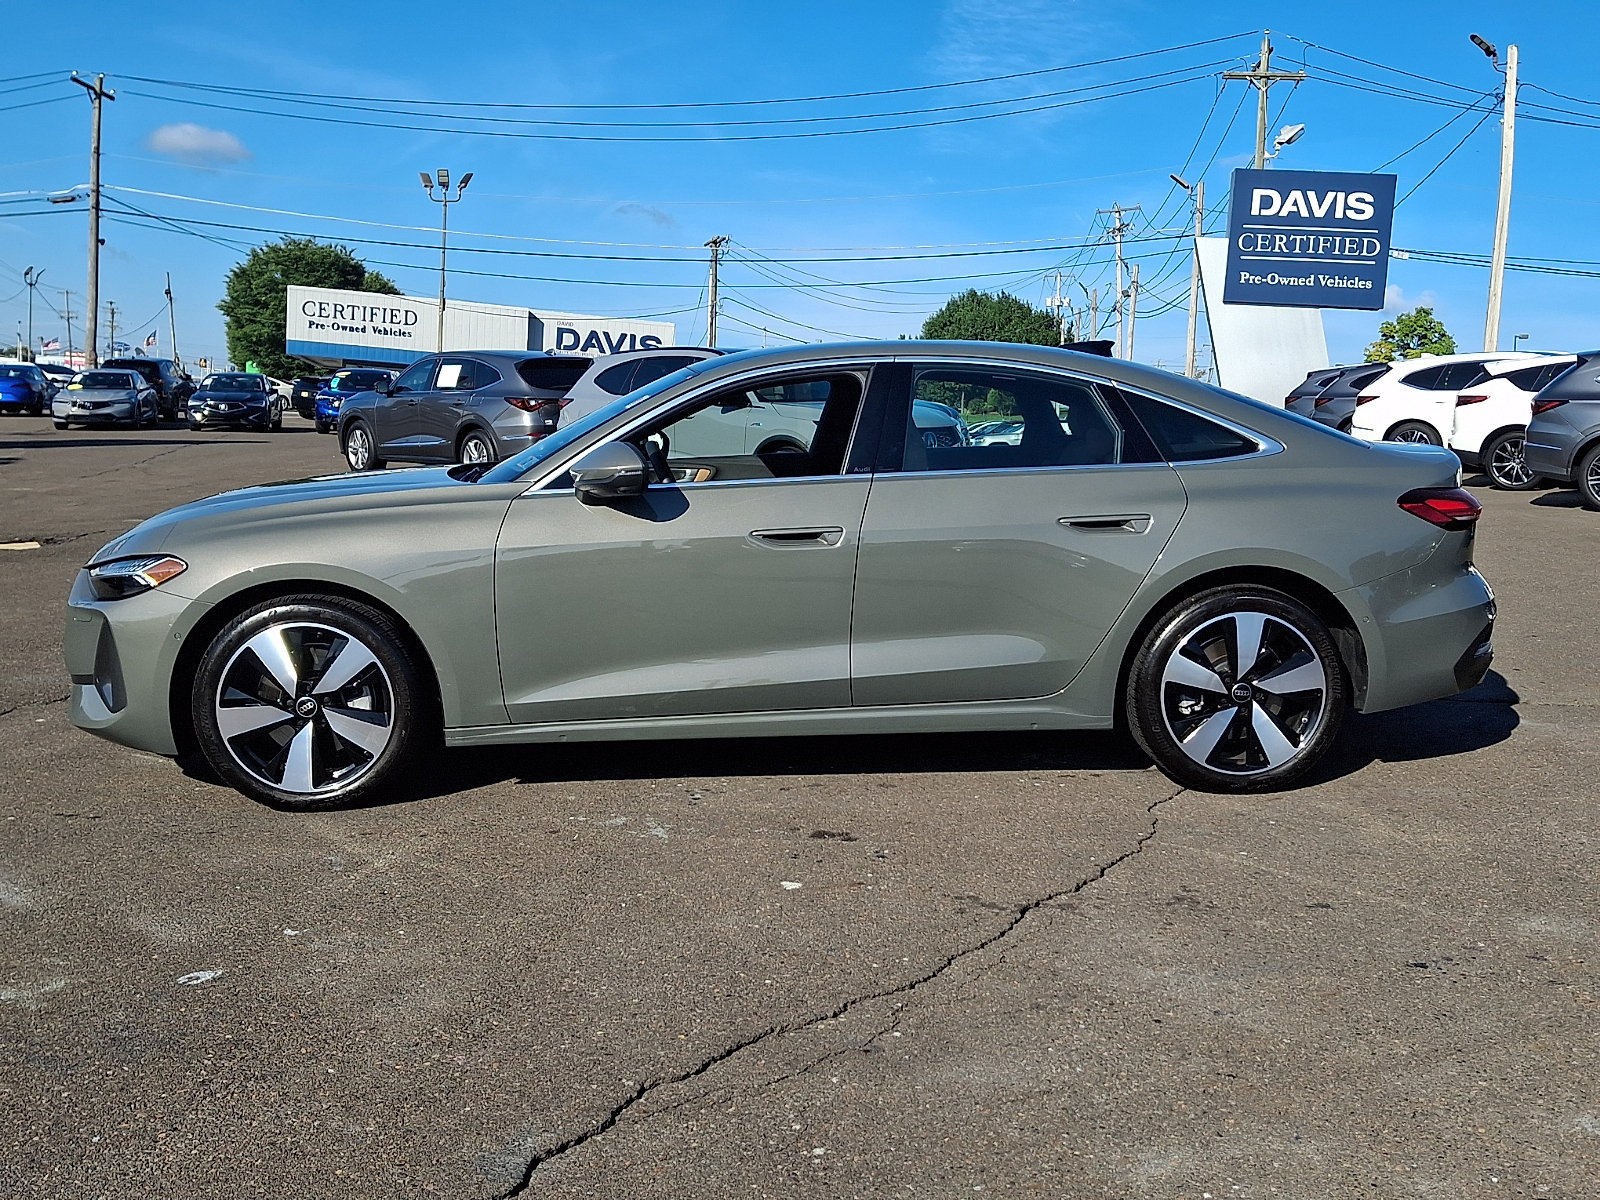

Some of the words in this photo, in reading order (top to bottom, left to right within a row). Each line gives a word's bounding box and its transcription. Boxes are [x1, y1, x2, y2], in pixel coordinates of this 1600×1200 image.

[1250, 188, 1375, 221] DAVIS
[1238, 232, 1381, 257] CERTIFIED
[1239, 271, 1315, 287] Pre-Owned
[1318, 274, 1373, 289] Vehicles
[301, 300, 418, 326] CERTIFIED
[308, 320, 366, 334] Pre-Owned
[372, 325, 413, 338] Vehicles
[555, 326, 663, 355] DAVIS
